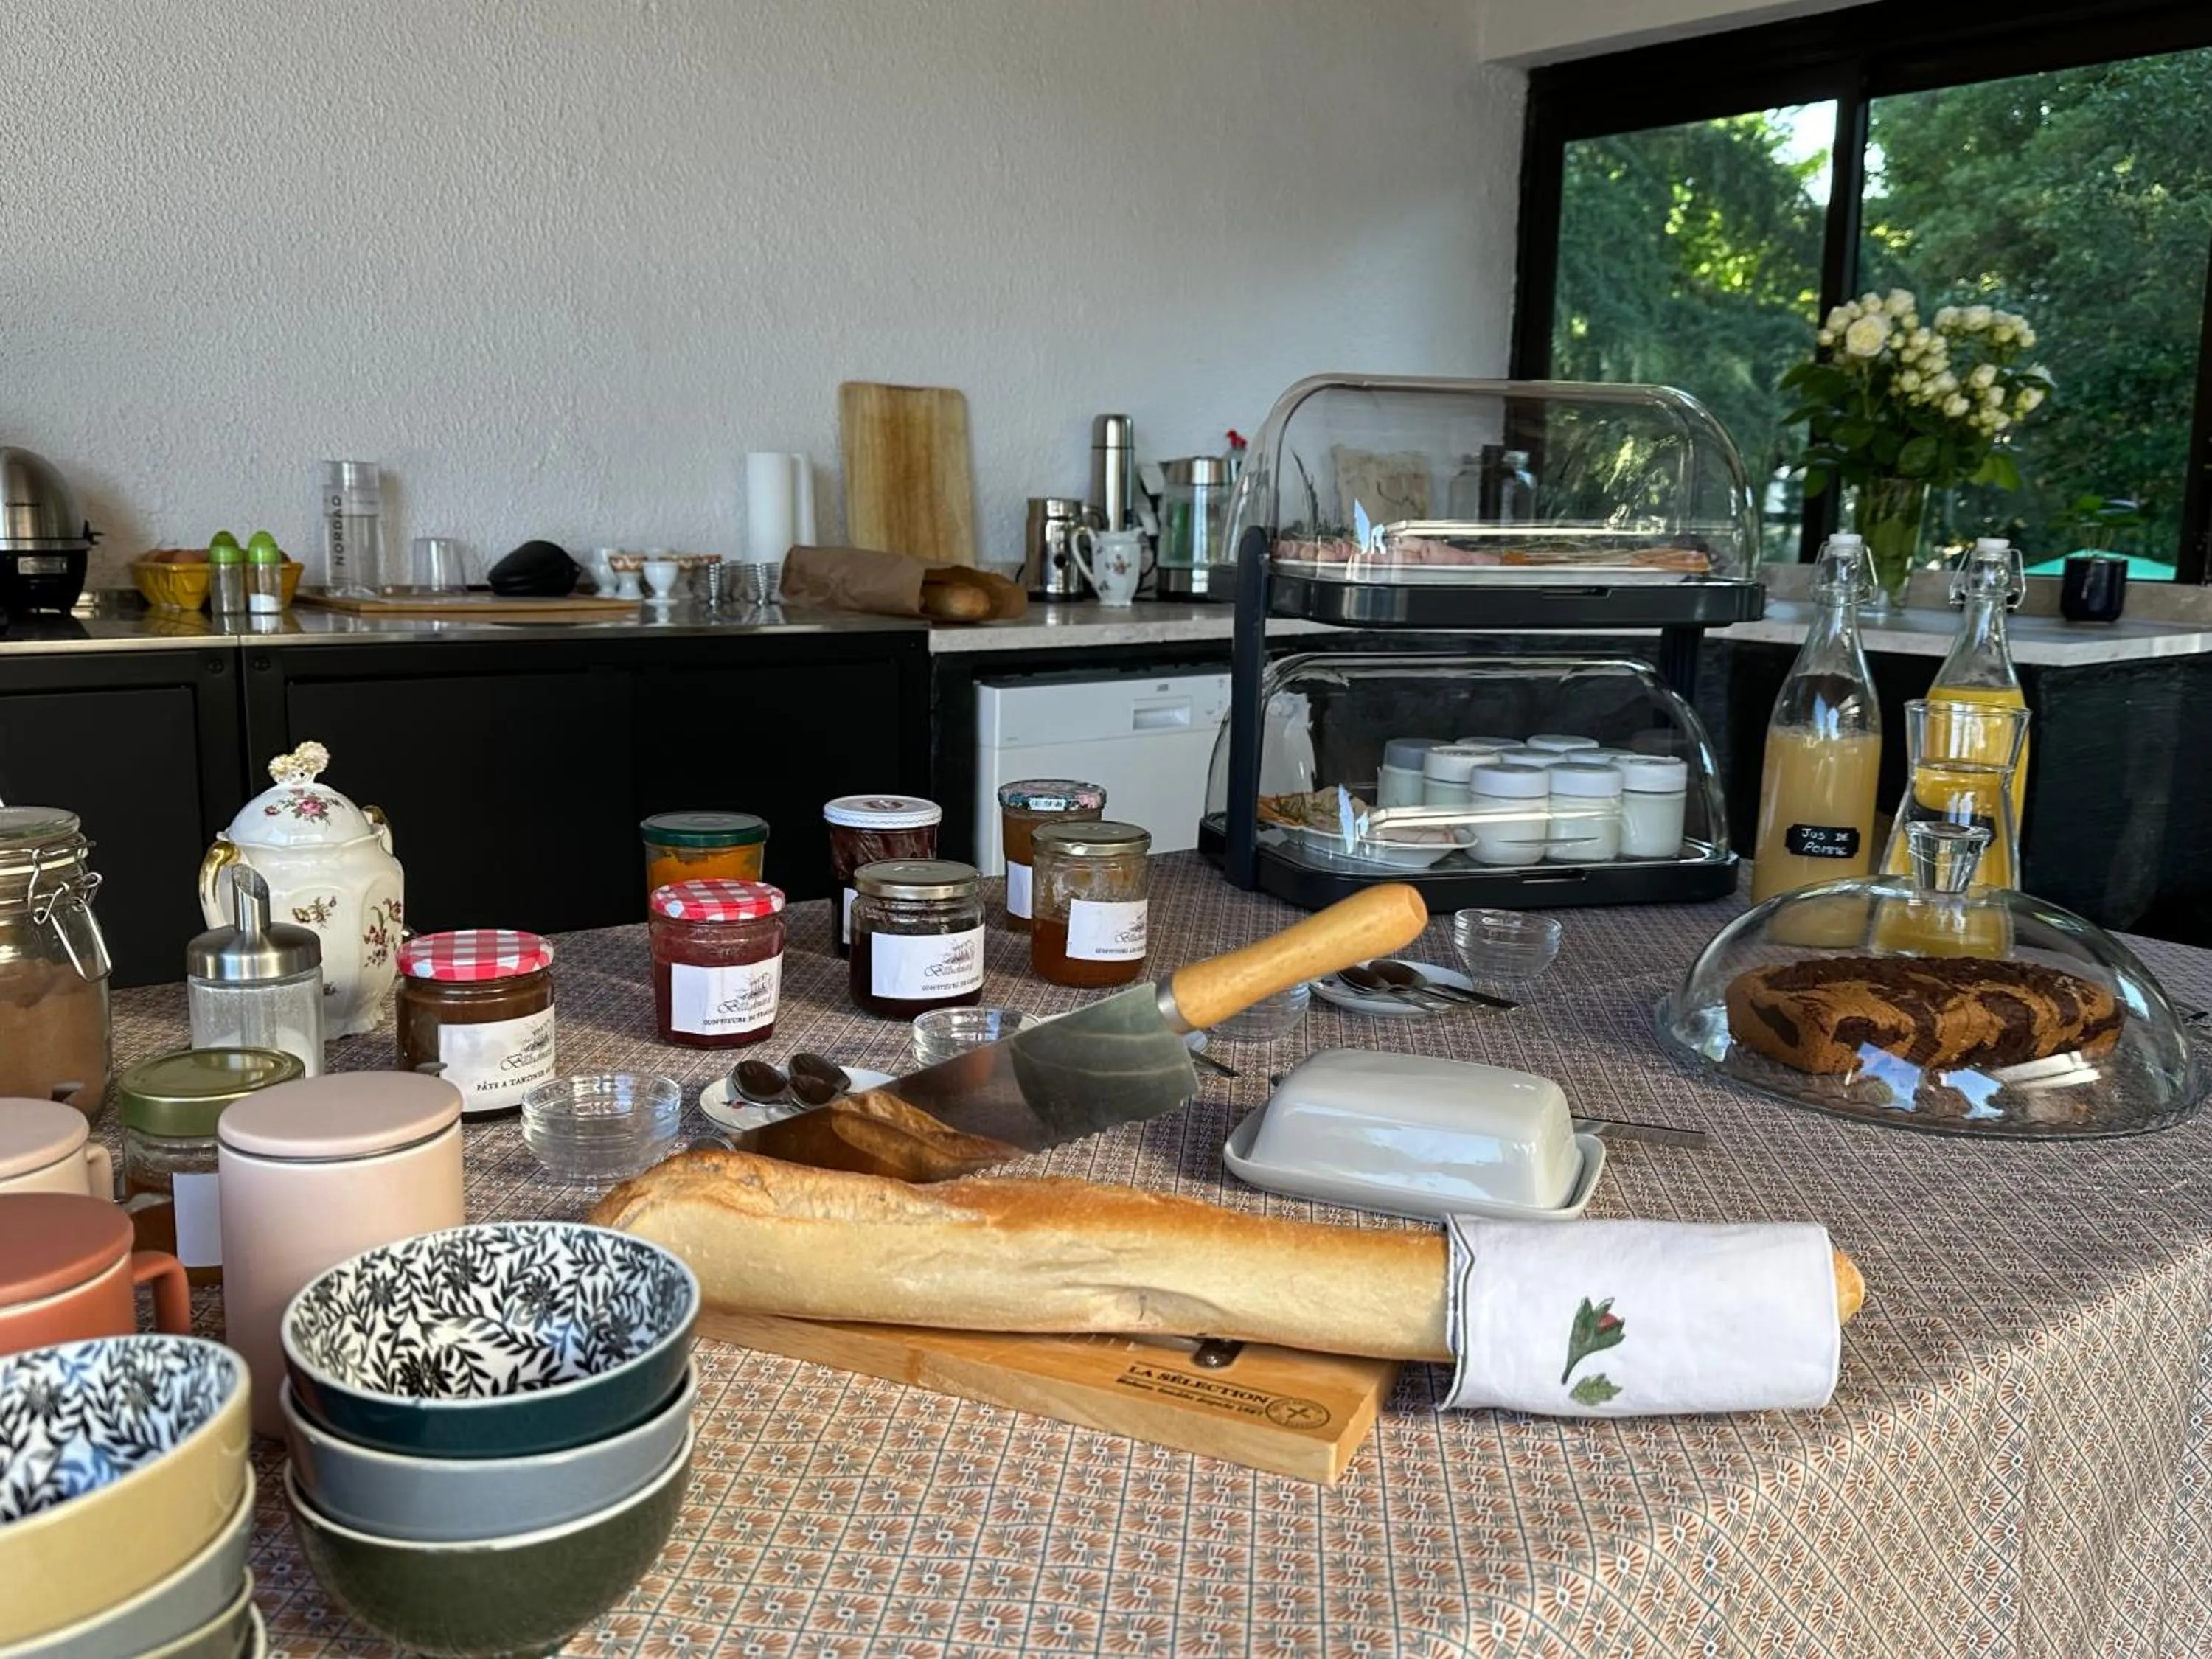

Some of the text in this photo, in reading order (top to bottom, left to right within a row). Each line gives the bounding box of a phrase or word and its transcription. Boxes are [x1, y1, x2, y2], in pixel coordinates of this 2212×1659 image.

[476, 1079, 499, 1091] PÂTE
[1127, 1365, 1152, 1378] LA
[1157, 1371, 1270, 1405] SÉLECTION
